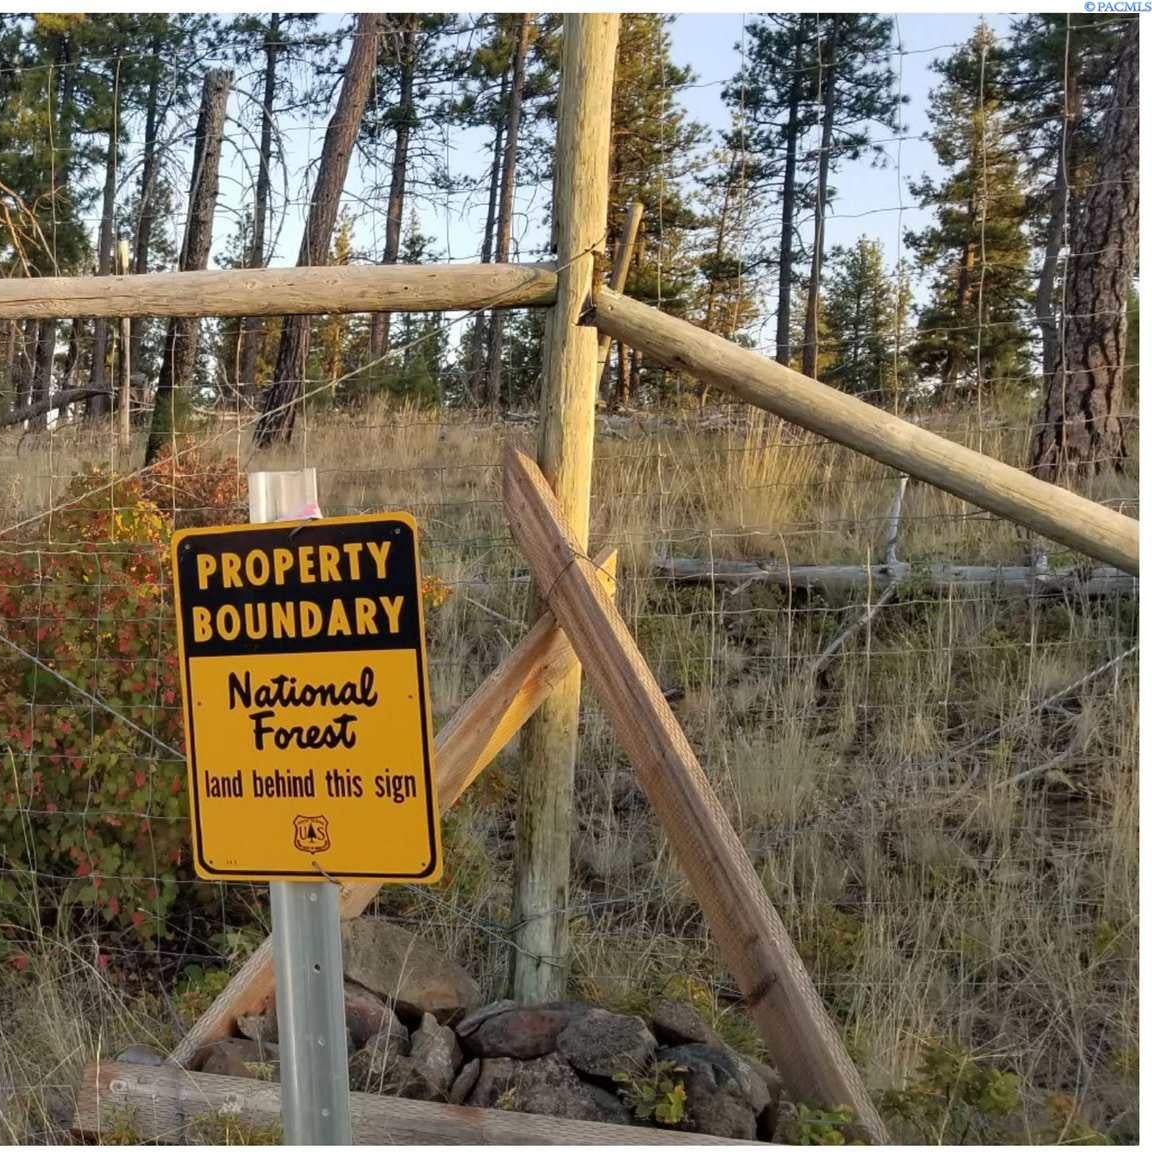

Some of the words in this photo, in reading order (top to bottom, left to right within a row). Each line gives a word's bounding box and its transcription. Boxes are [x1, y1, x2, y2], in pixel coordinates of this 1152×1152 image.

[196, 541, 392, 590] PROPERTY
[192, 596, 405, 643] BOUNDARY
[228, 666, 378, 710] National
[249, 710, 357, 751] Forest
[205, 770, 243, 798] land
[253, 768, 315, 798] behind
[325, 768, 363, 797] this
[375, 768, 417, 803] sign
